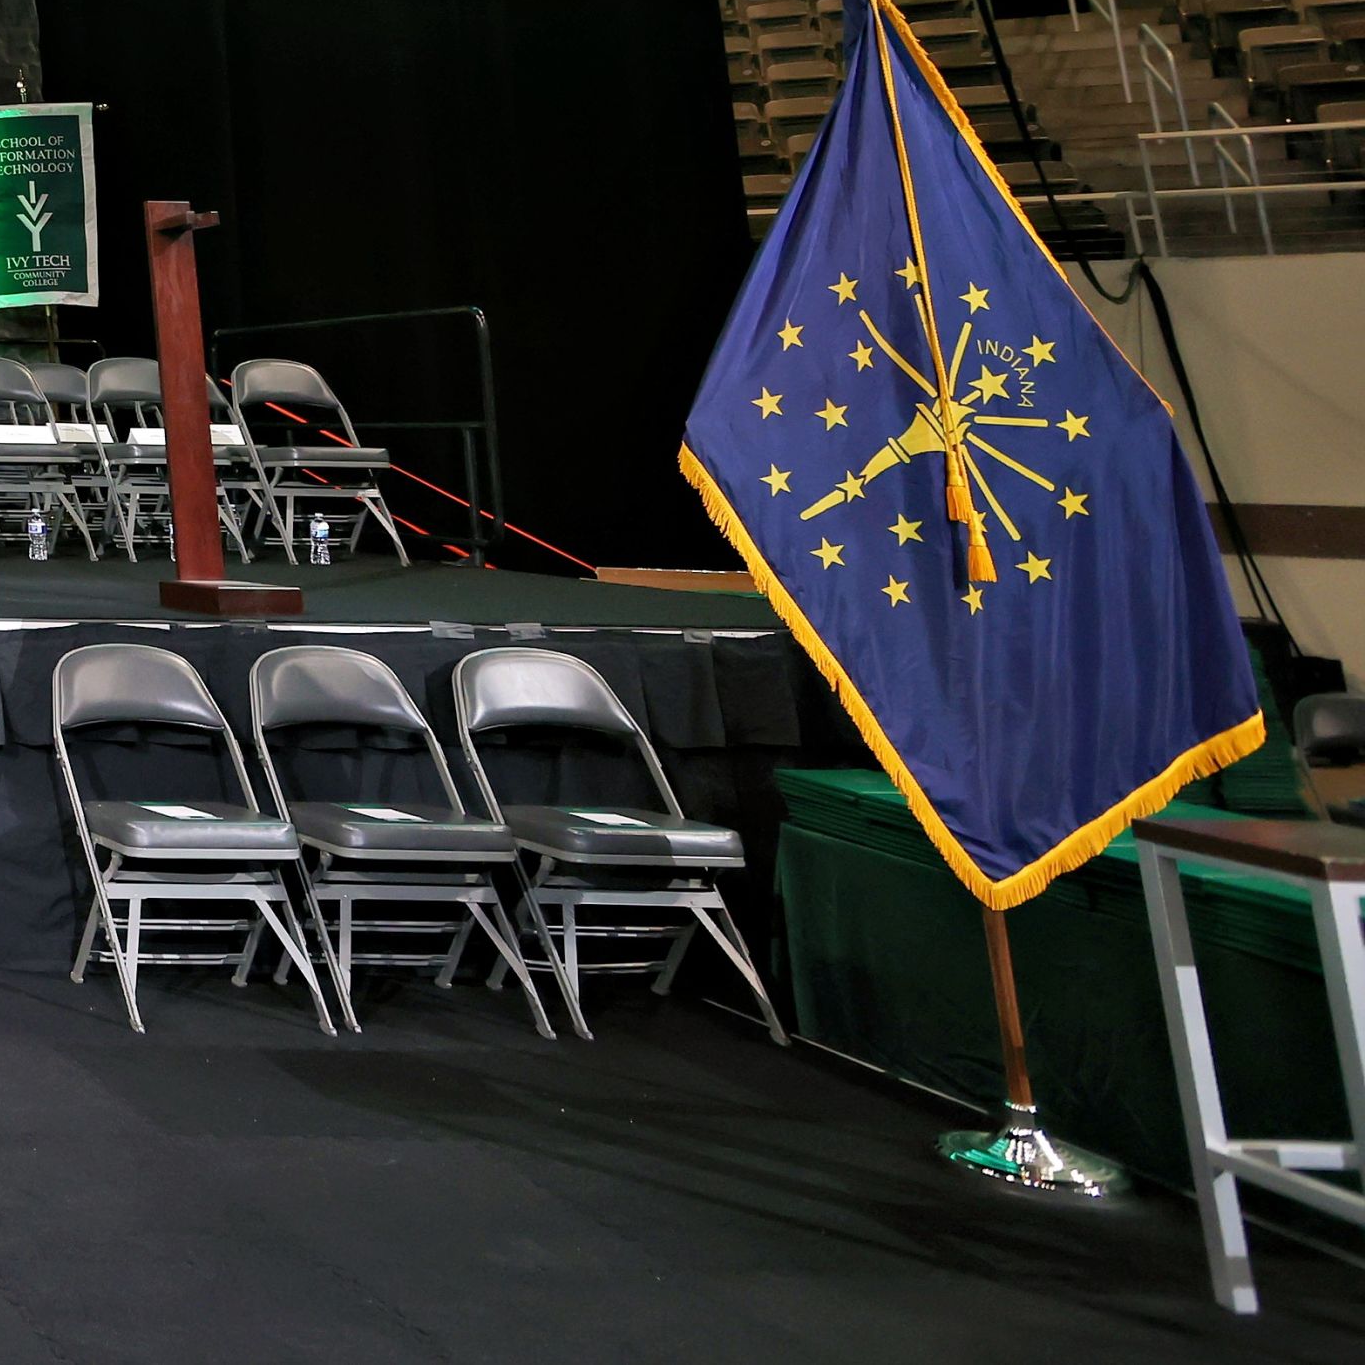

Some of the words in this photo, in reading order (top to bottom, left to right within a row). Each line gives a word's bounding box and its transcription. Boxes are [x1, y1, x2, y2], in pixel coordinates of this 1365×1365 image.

[48, 135, 64, 146] OF
[6, 256, 30, 270] IVY
[32, 254, 70, 268] TECH
[13, 270, 67, 281] COMMUNITY
[22, 278, 59, 288] COLLEGE
[976, 339, 1037, 408] INDIANA
